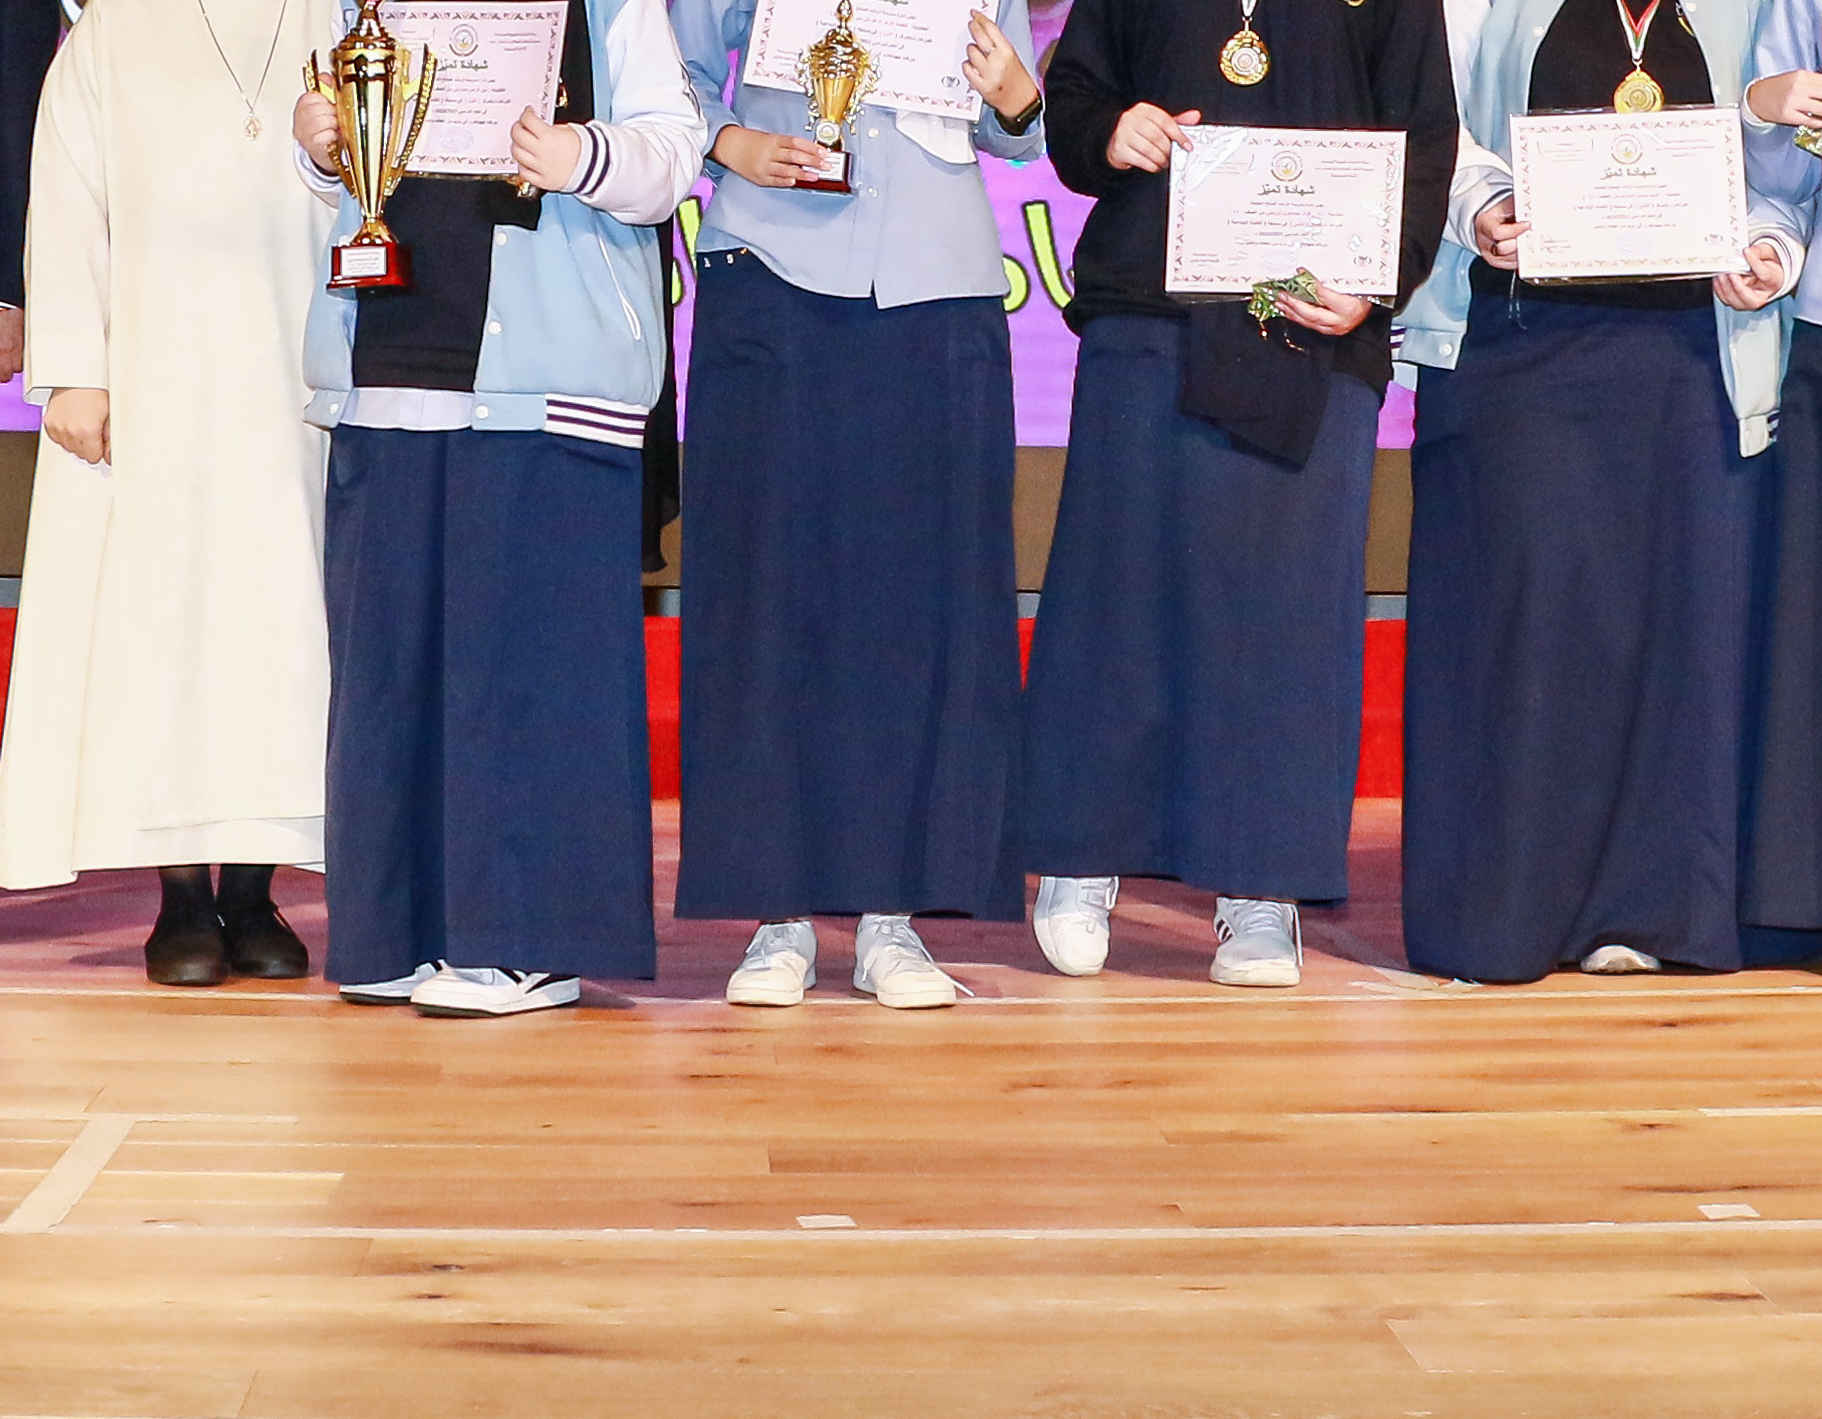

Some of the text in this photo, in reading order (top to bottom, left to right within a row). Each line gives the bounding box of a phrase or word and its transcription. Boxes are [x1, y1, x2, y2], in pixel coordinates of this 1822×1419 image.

[461, 59, 489, 72] شهادة
[1626, 166, 1657, 179] شهادة
[1284, 184, 1315, 197] شهادة
